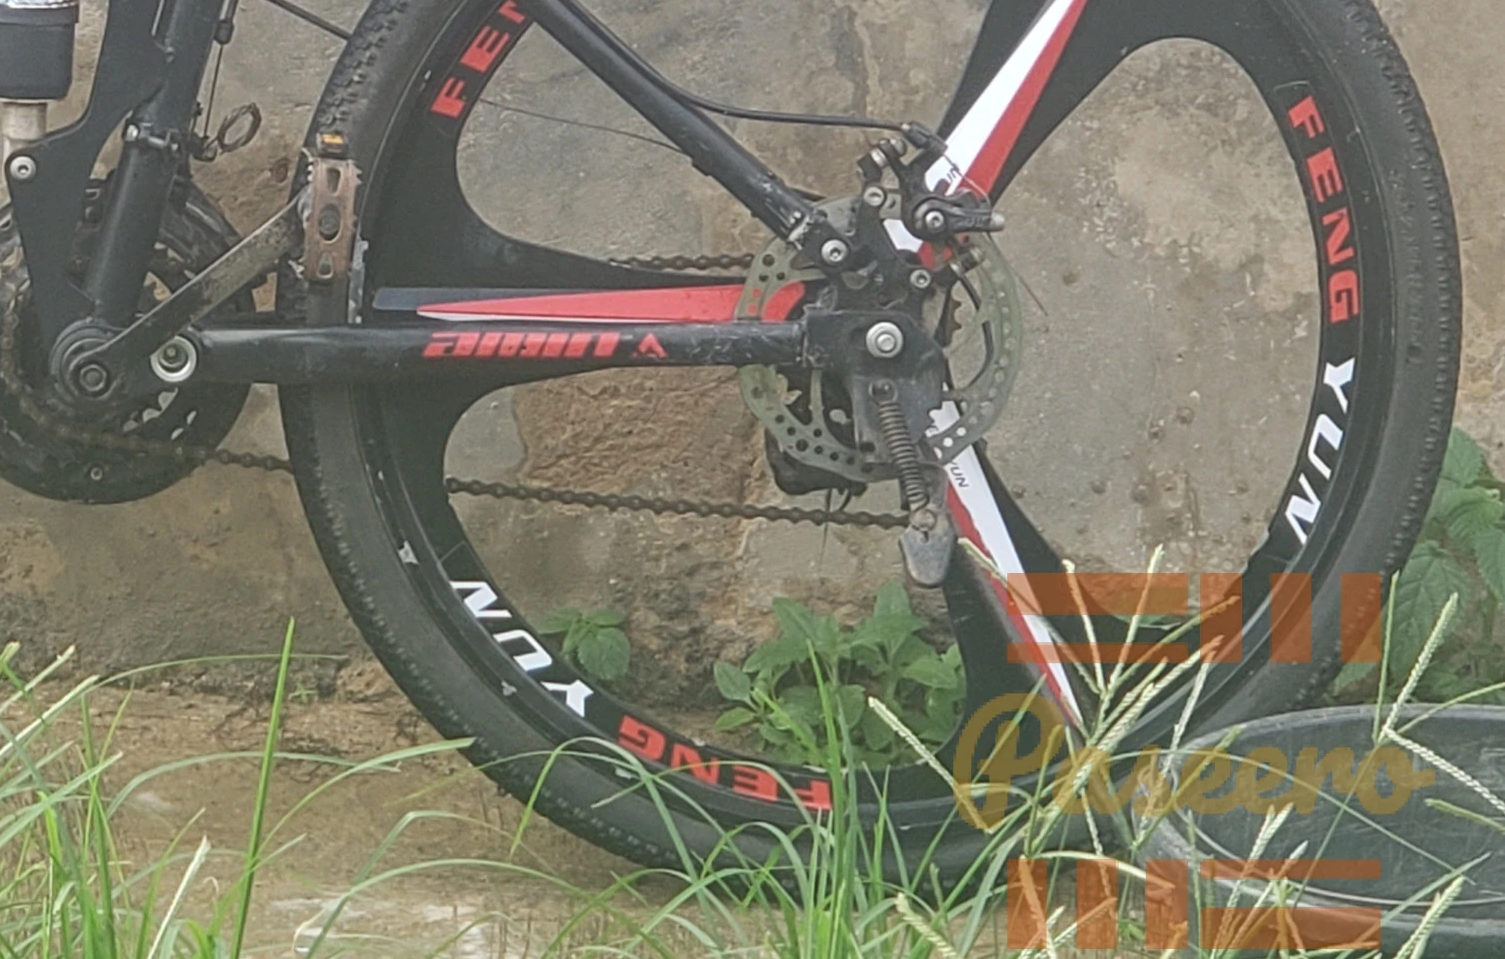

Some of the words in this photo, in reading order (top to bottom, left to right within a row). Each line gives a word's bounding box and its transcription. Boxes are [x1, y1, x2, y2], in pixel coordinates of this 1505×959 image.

[1287, 95, 1362, 324] FENG
[1284, 357, 1356, 546] YUN
[448, 580, 595, 719] YUN
[617, 714, 833, 811] FENG
